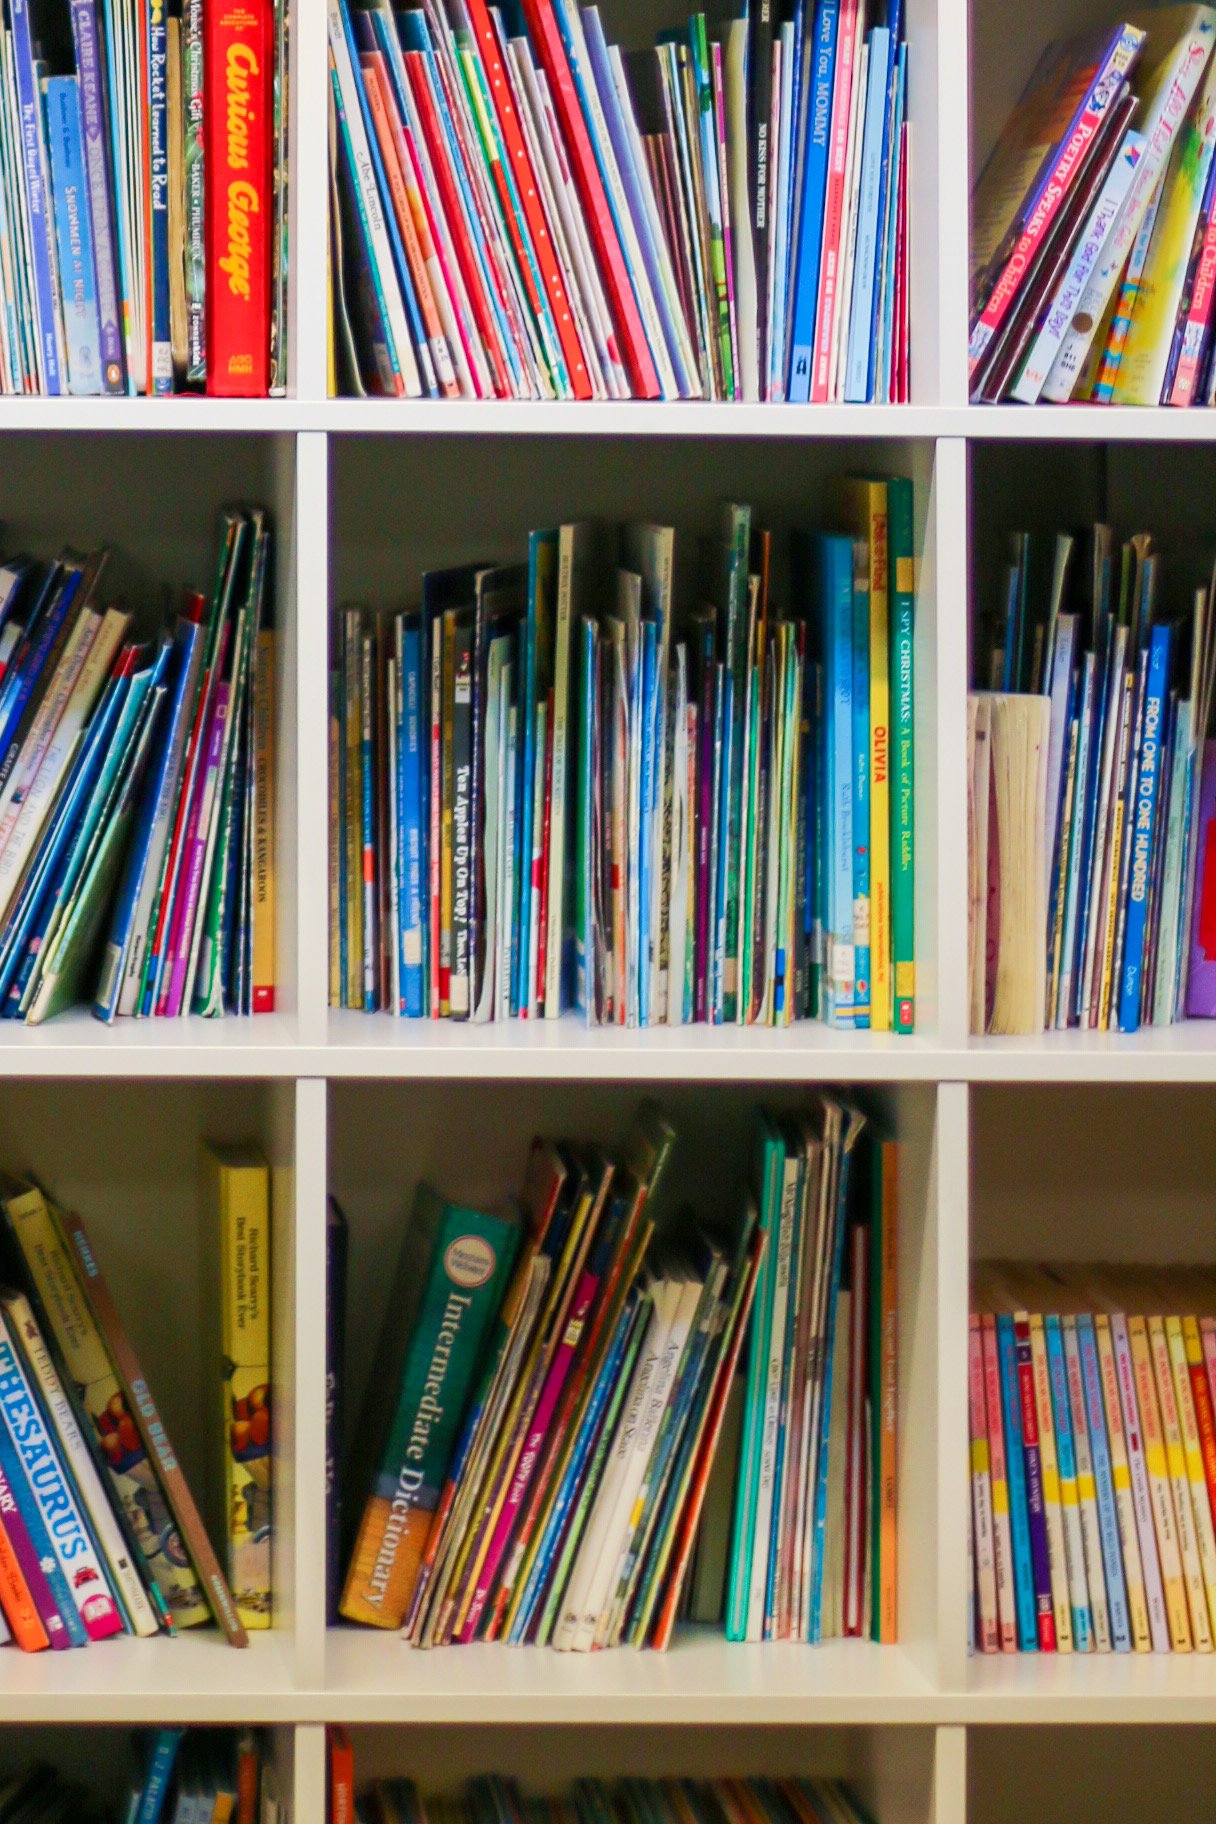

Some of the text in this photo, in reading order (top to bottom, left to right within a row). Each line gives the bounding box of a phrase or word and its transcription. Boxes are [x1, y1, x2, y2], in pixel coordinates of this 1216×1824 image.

[821, 9, 835, 42] Love
[189, 41, 203, 96] Christmas
[817, 48, 832, 78] You,
[151, 26, 167, 210] How Rocket Learned to Read
[189, 98, 203, 121] Gift
[225, 42, 260, 170] Curious
[813, 82, 829, 147] MOMMY
[356, 152, 382, 231] Abe Lincoln
[755, 123, 767, 228] NO KISS FOR MOTHER
[218, 181, 259, 297] George
[987, 121, 1094, 314] POETRY SPEAKS to Children
[900, 610, 911, 636] SPY
[900, 639, 911, 722] CHRISTMAS:
[874, 726, 886, 784] OLIVIA
[901, 739, 911, 768] Book
[902, 772, 911, 785] of
[901, 788, 911, 825] Picture
[1130, 697, 1160, 903] FROM ONE TO ONE HUNDRED
[452, 765, 470, 923] Ten Apples Up On Top!
[901, 830, 912, 871] Riddles
[235, 1217, 248, 1329] Best Storybook Ever
[248, 1228, 260, 1272] Richard
[131, 1379, 178, 1473] OLD BEAR
[360, 1291, 472, 1612] Intermediate Dictionary
